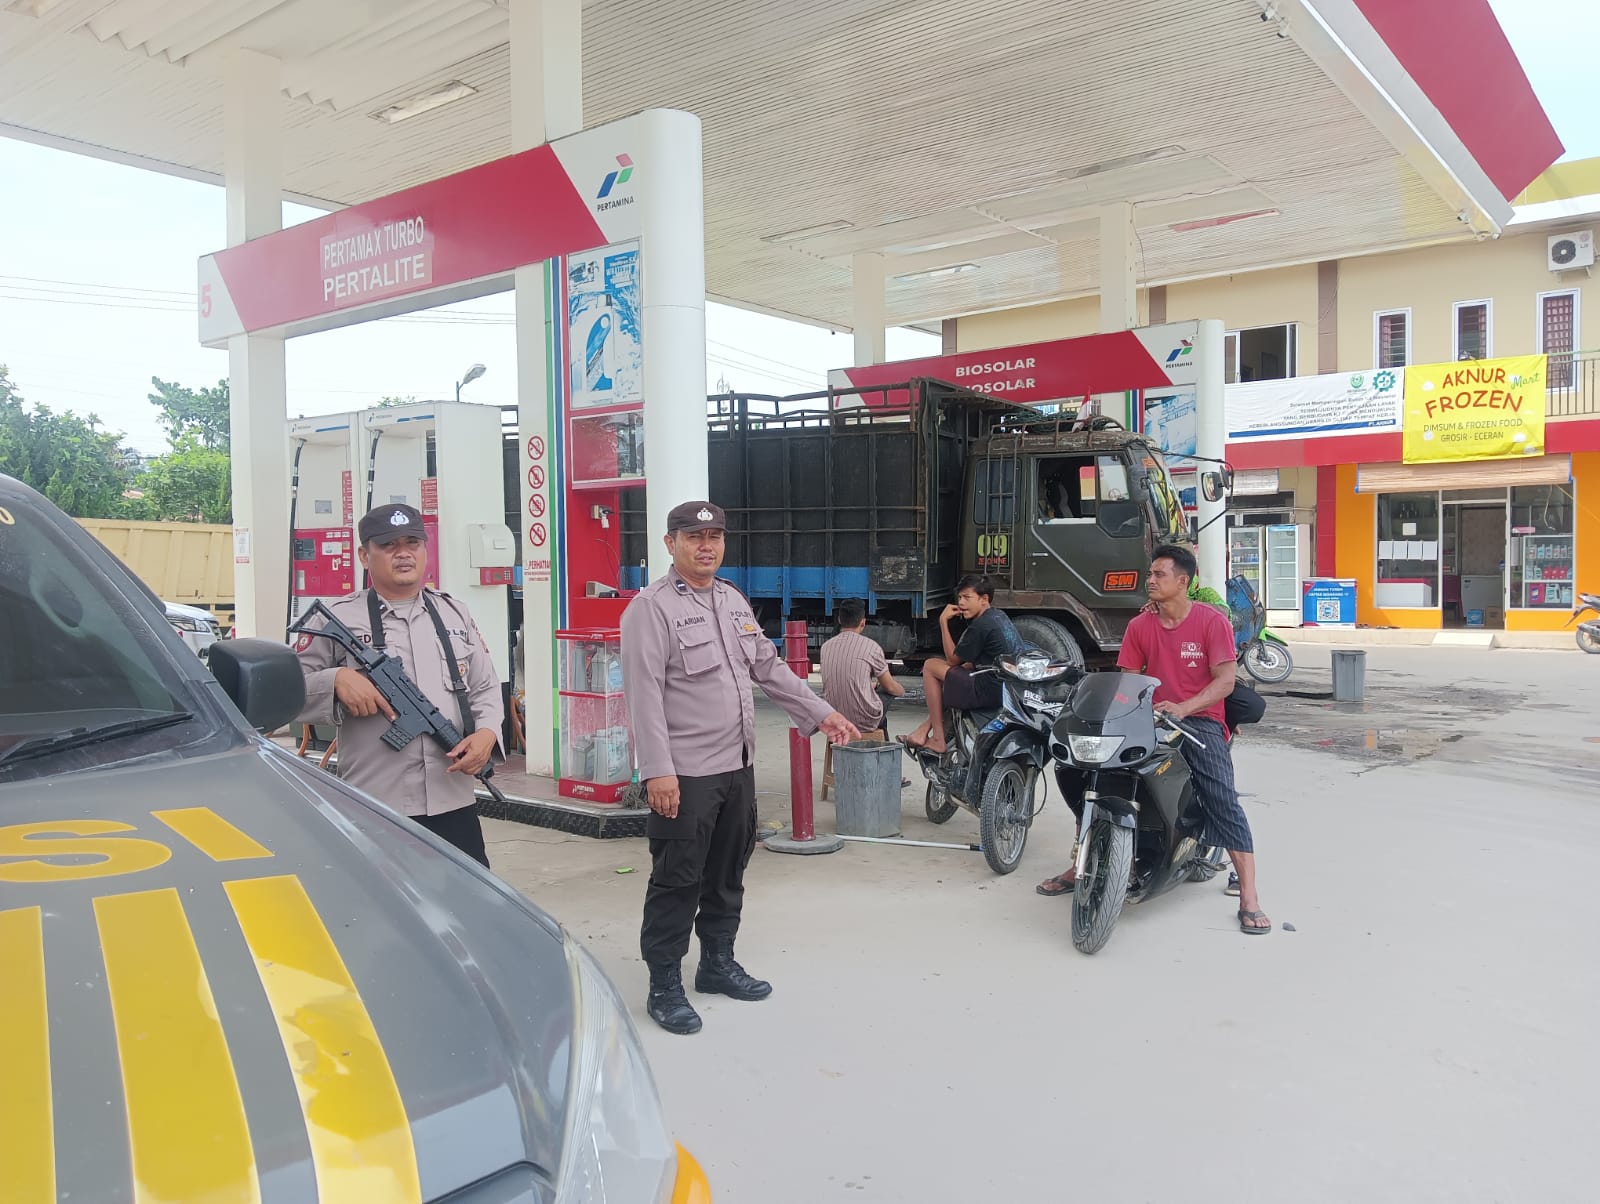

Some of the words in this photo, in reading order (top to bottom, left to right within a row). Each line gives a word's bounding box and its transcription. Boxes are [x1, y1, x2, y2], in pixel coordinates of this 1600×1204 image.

[597, 197, 634, 212] PERTAMINA
[323, 229, 381, 270] PERTAMAX
[384, 216, 425, 254] TURBO
[323, 254, 425, 301] PERTALITE
[200, 282, 213, 318] 5
[955, 357, 1036, 378] BIOSOLAR
[965, 378, 1036, 394] OSOLAR
[1442, 368, 1506, 389] AKNUR
[1510, 372, 1541, 390] Mart
[1425, 390, 1523, 419] FROZEN
[1424, 423, 1457, 432] DIMSUM
[1457, 422, 1464, 430] &
[1466, 420, 1497, 430] FROZEN
[1499, 418, 1523, 427] FOOD
[1441, 433, 1468, 442] GROSIR
[1474, 431, 1504, 440] ECERAN
[977, 534, 1008, 558] 09
[1106, 573, 1135, 587] SM
